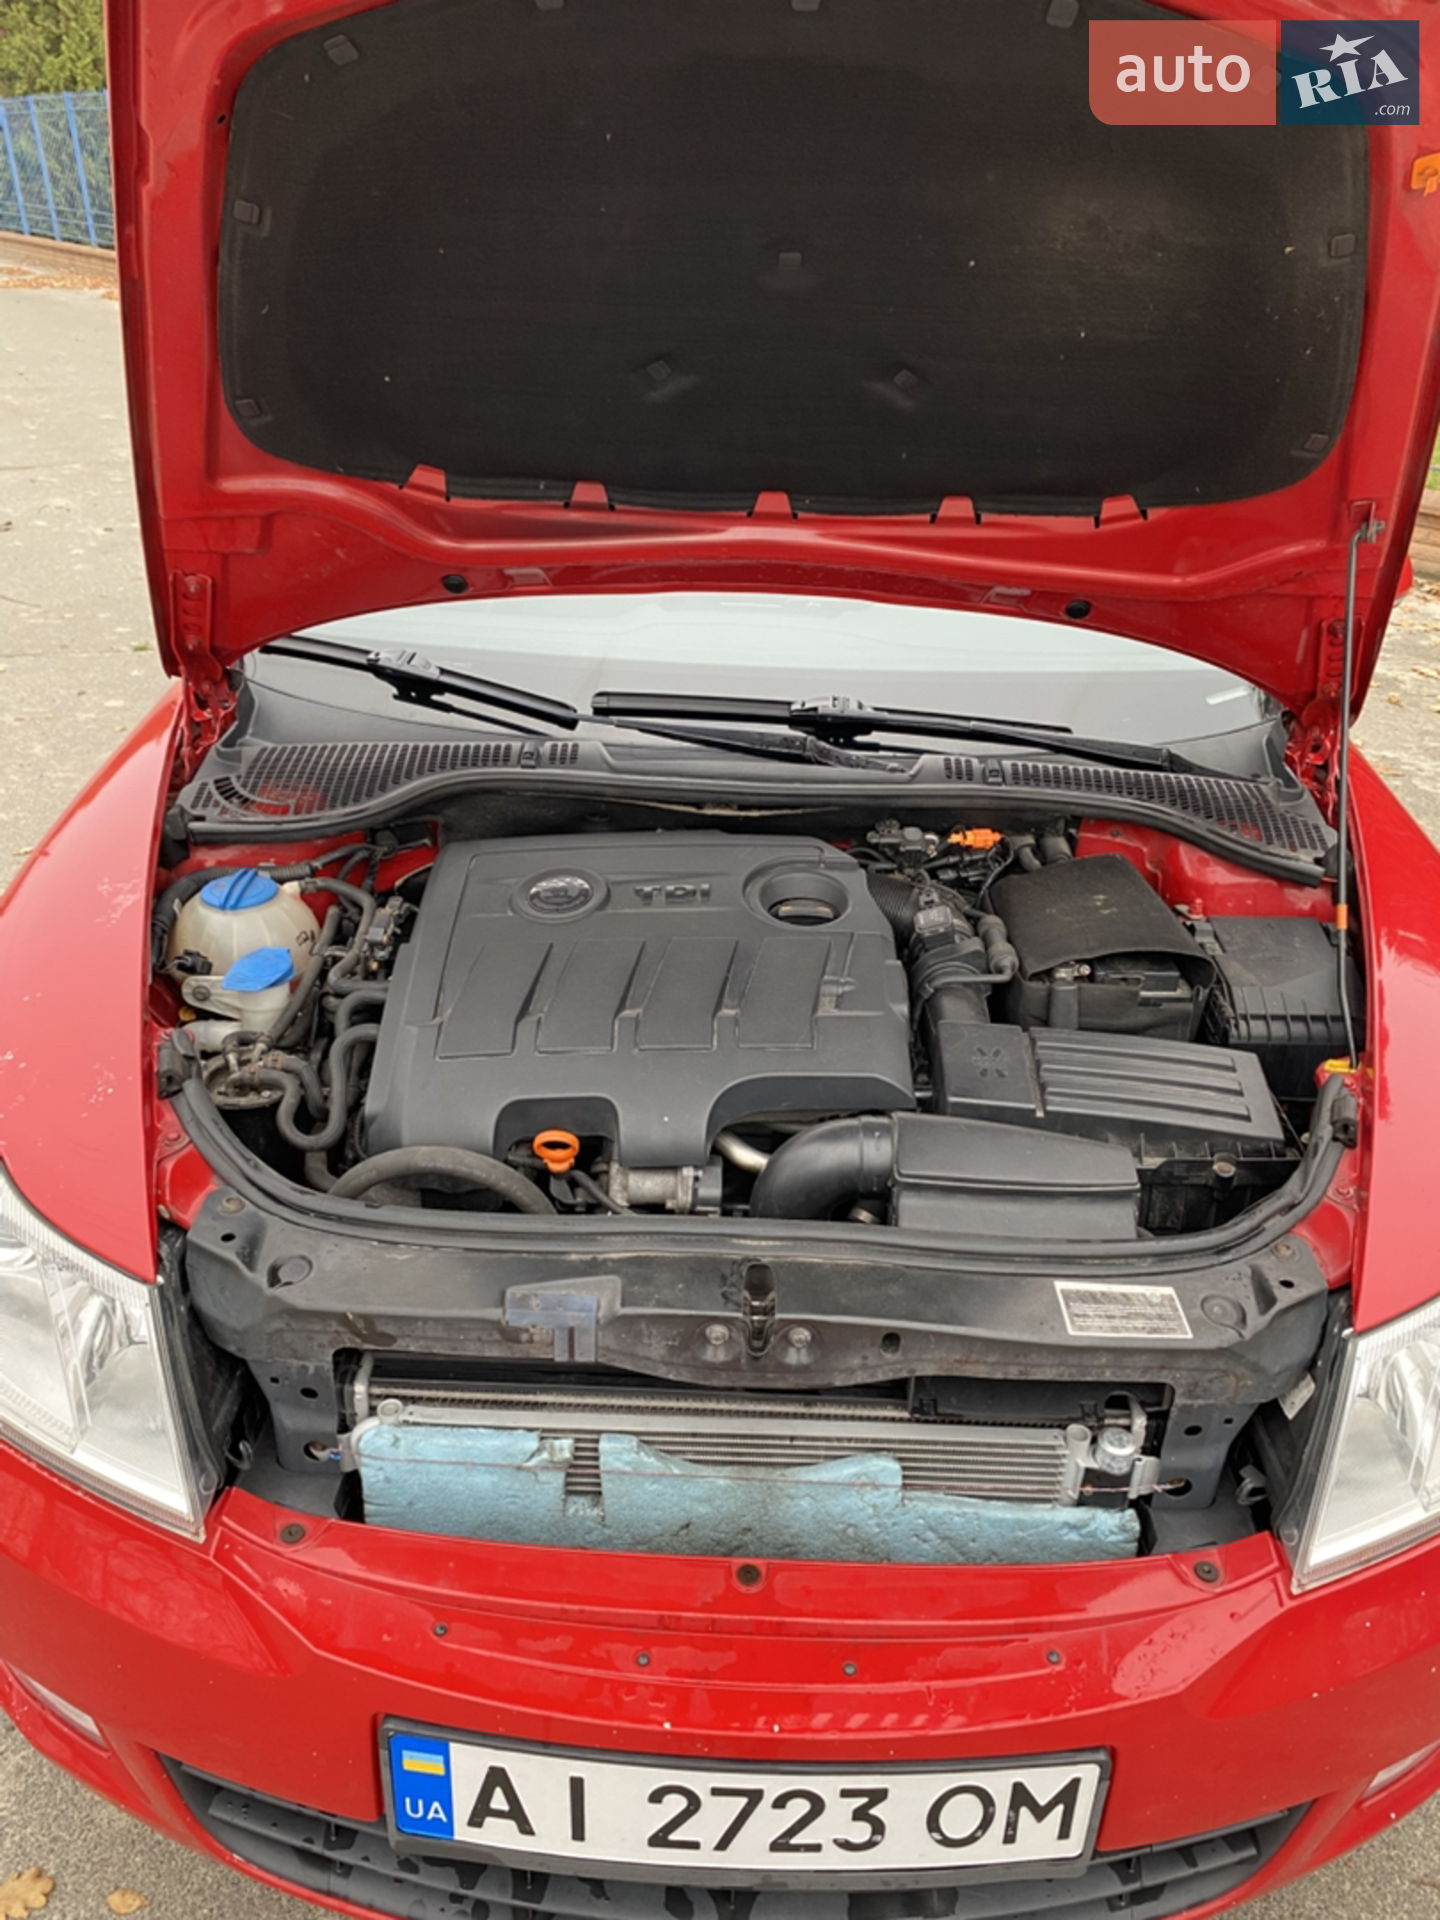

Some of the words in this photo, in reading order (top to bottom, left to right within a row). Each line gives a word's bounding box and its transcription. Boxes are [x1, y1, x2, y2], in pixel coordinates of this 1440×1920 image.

[634, 883, 711, 905] TDI
[405, 1796, 448, 1823] UA
[647, 1784, 889, 1853] 2723
[926, 1776, 1082, 1848] OM
